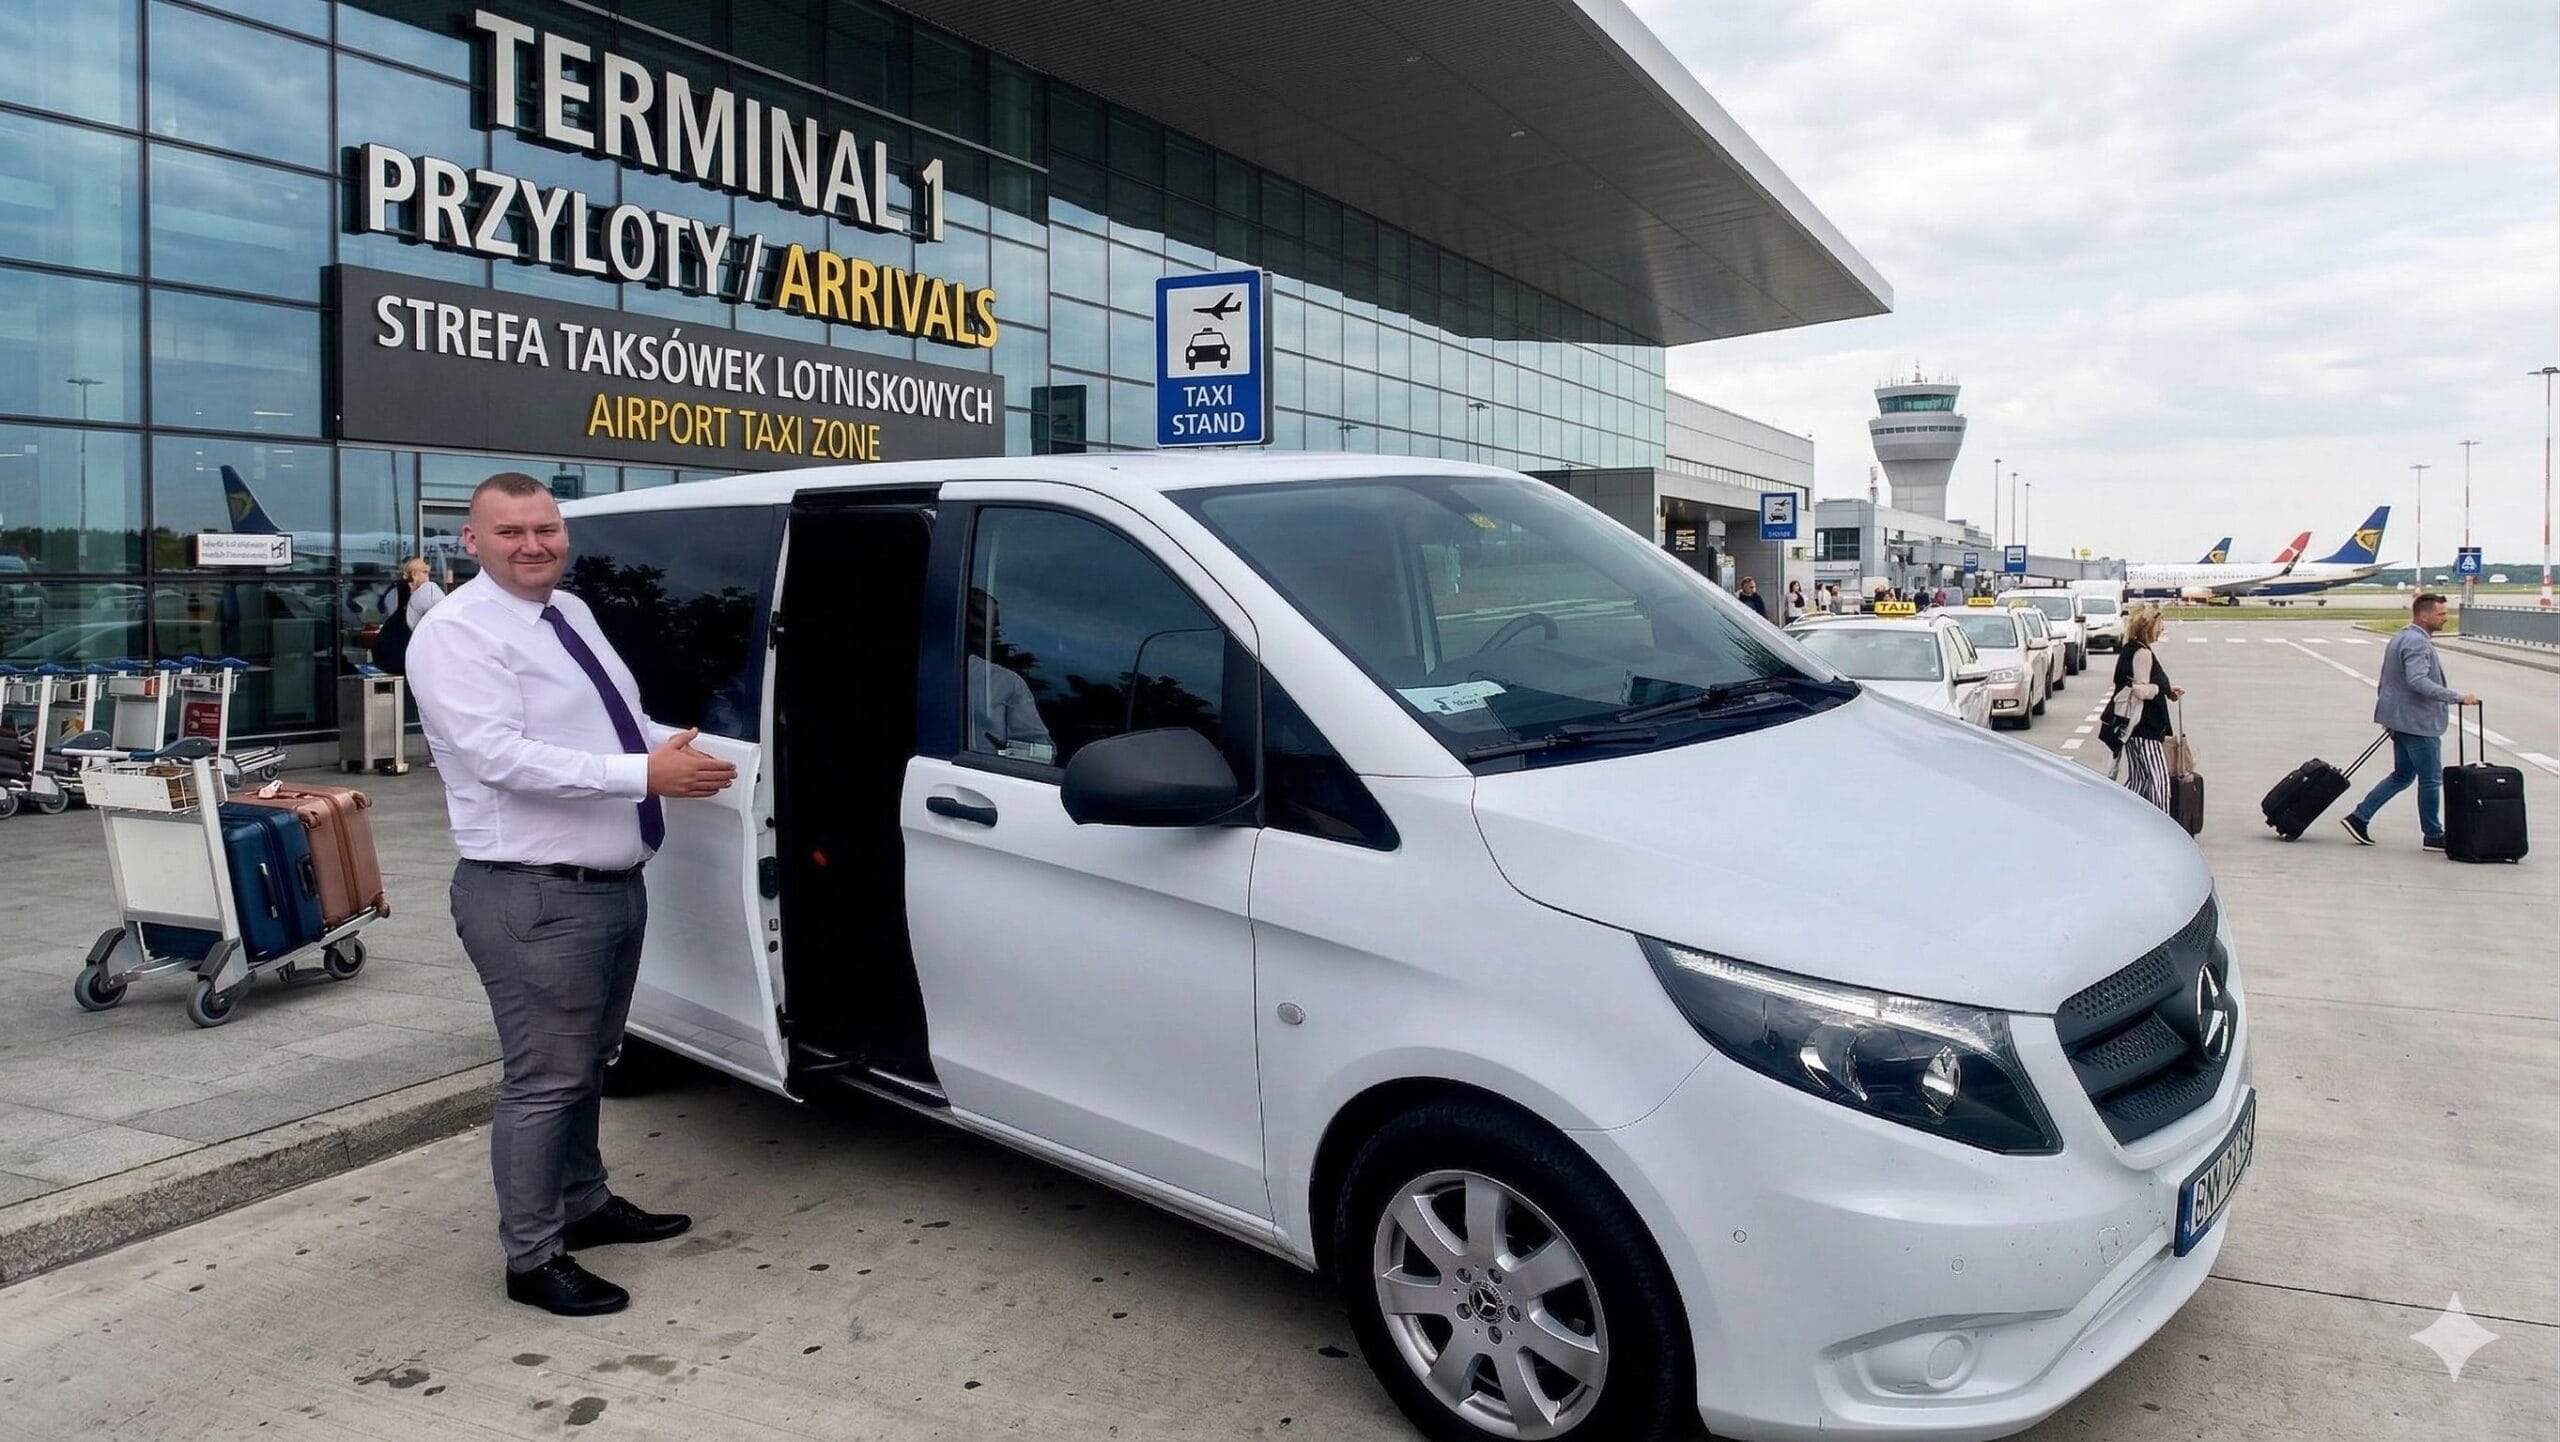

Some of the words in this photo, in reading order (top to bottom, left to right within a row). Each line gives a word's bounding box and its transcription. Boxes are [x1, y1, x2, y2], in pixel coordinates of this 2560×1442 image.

[472, 8, 904, 234] TERMINAL
[921, 157, 945, 242] 1
[362, 142, 730, 296] PRZYLOTY
[778, 243, 999, 349] ARRIVALS
[377, 295, 549, 367] STREFA
[560, 322, 765, 395] TAKSÓWEK
[777, 356, 994, 425] LOTNISKOWYCH
[1183, 385, 1233, 407] TAXI
[588, 393, 731, 450] AIRPORT
[739, 410, 804, 456] TAXI
[811, 417, 881, 461] ZONE
[1172, 412, 1245, 436] STAND
